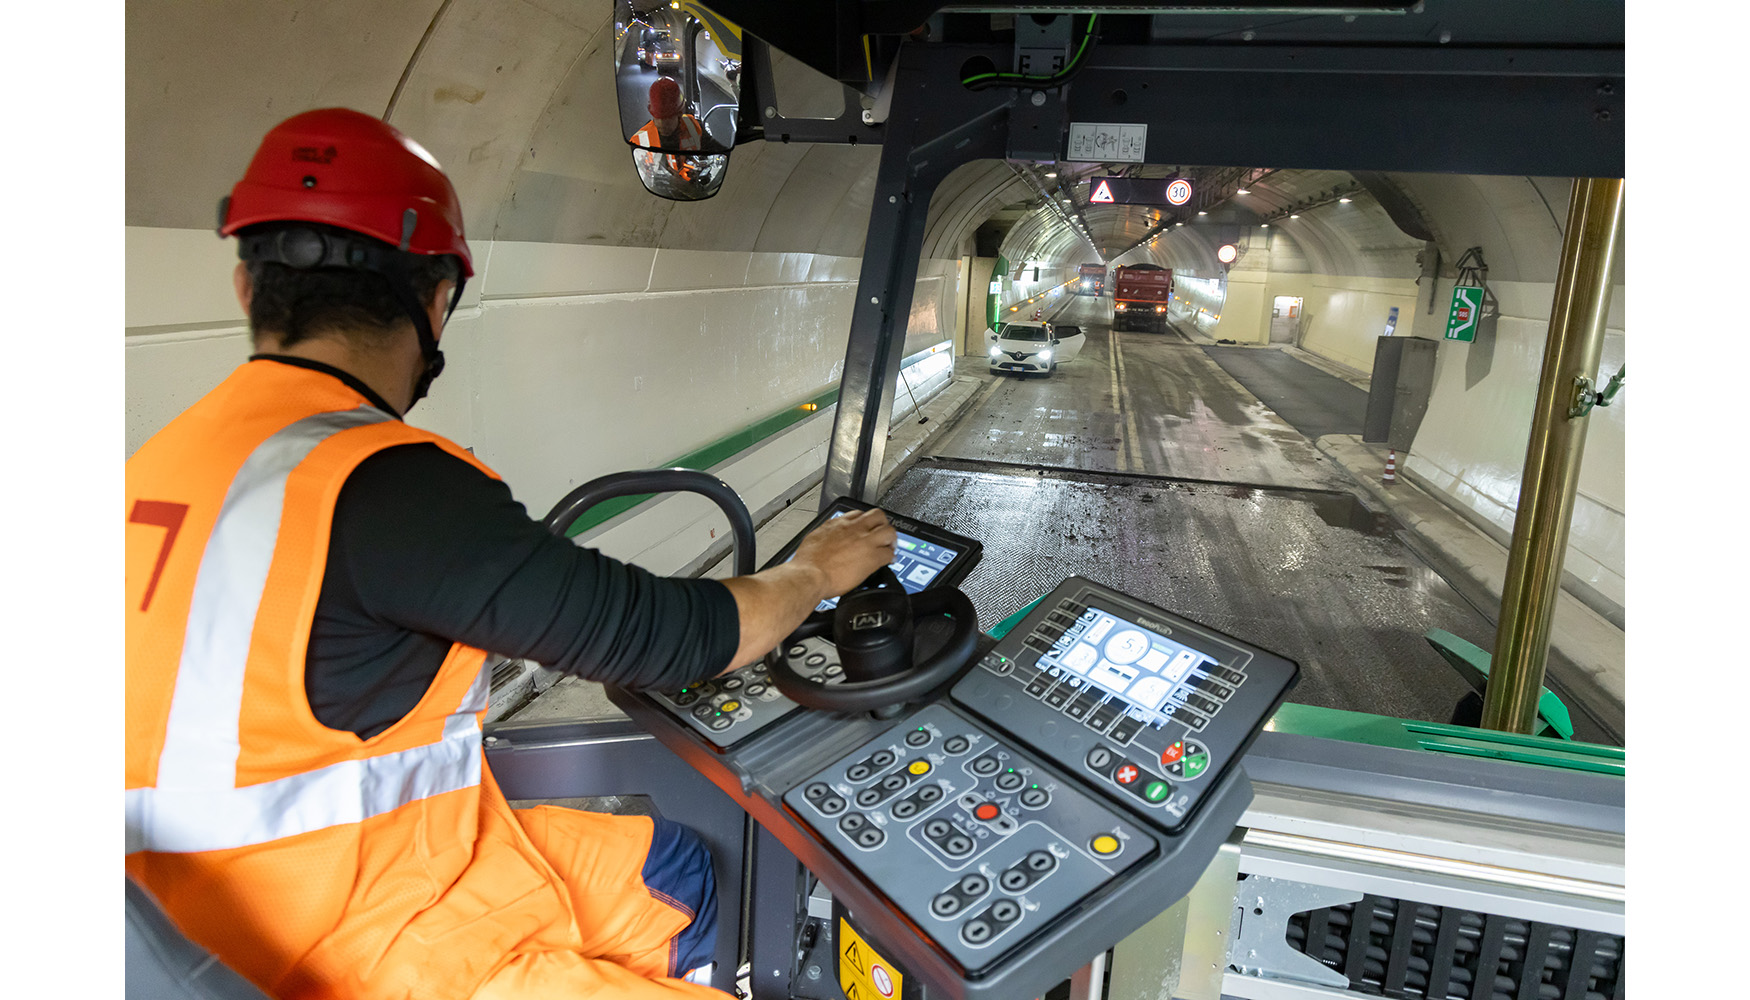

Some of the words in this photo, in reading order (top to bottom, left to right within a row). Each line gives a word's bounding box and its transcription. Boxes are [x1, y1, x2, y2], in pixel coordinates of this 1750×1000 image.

[1172, 187, 1185, 198] 30
[129, 500, 190, 612] 7
[1121, 638, 1144, 655] 5.1
